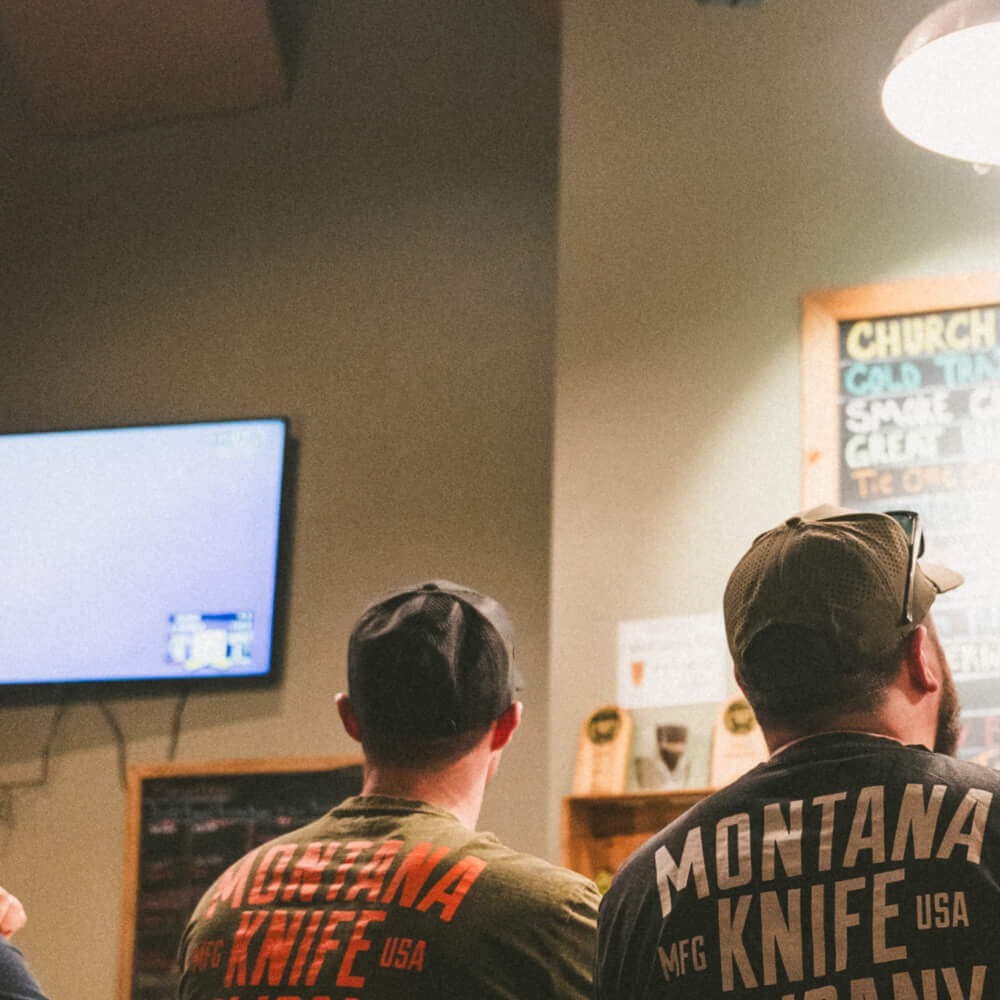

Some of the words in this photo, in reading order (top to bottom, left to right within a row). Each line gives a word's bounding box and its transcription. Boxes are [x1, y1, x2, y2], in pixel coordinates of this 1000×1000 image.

[846, 309, 996, 361] CHURCH
[205, 840, 488, 922] MONTANA
[654, 783, 993, 919] MONTANA
[223, 910, 387, 988] KNIFE
[379, 937, 427, 972] USA
[658, 935, 707, 982] MFG
[717, 868, 908, 992] KNIFE
[916, 891, 969, 930] USA
